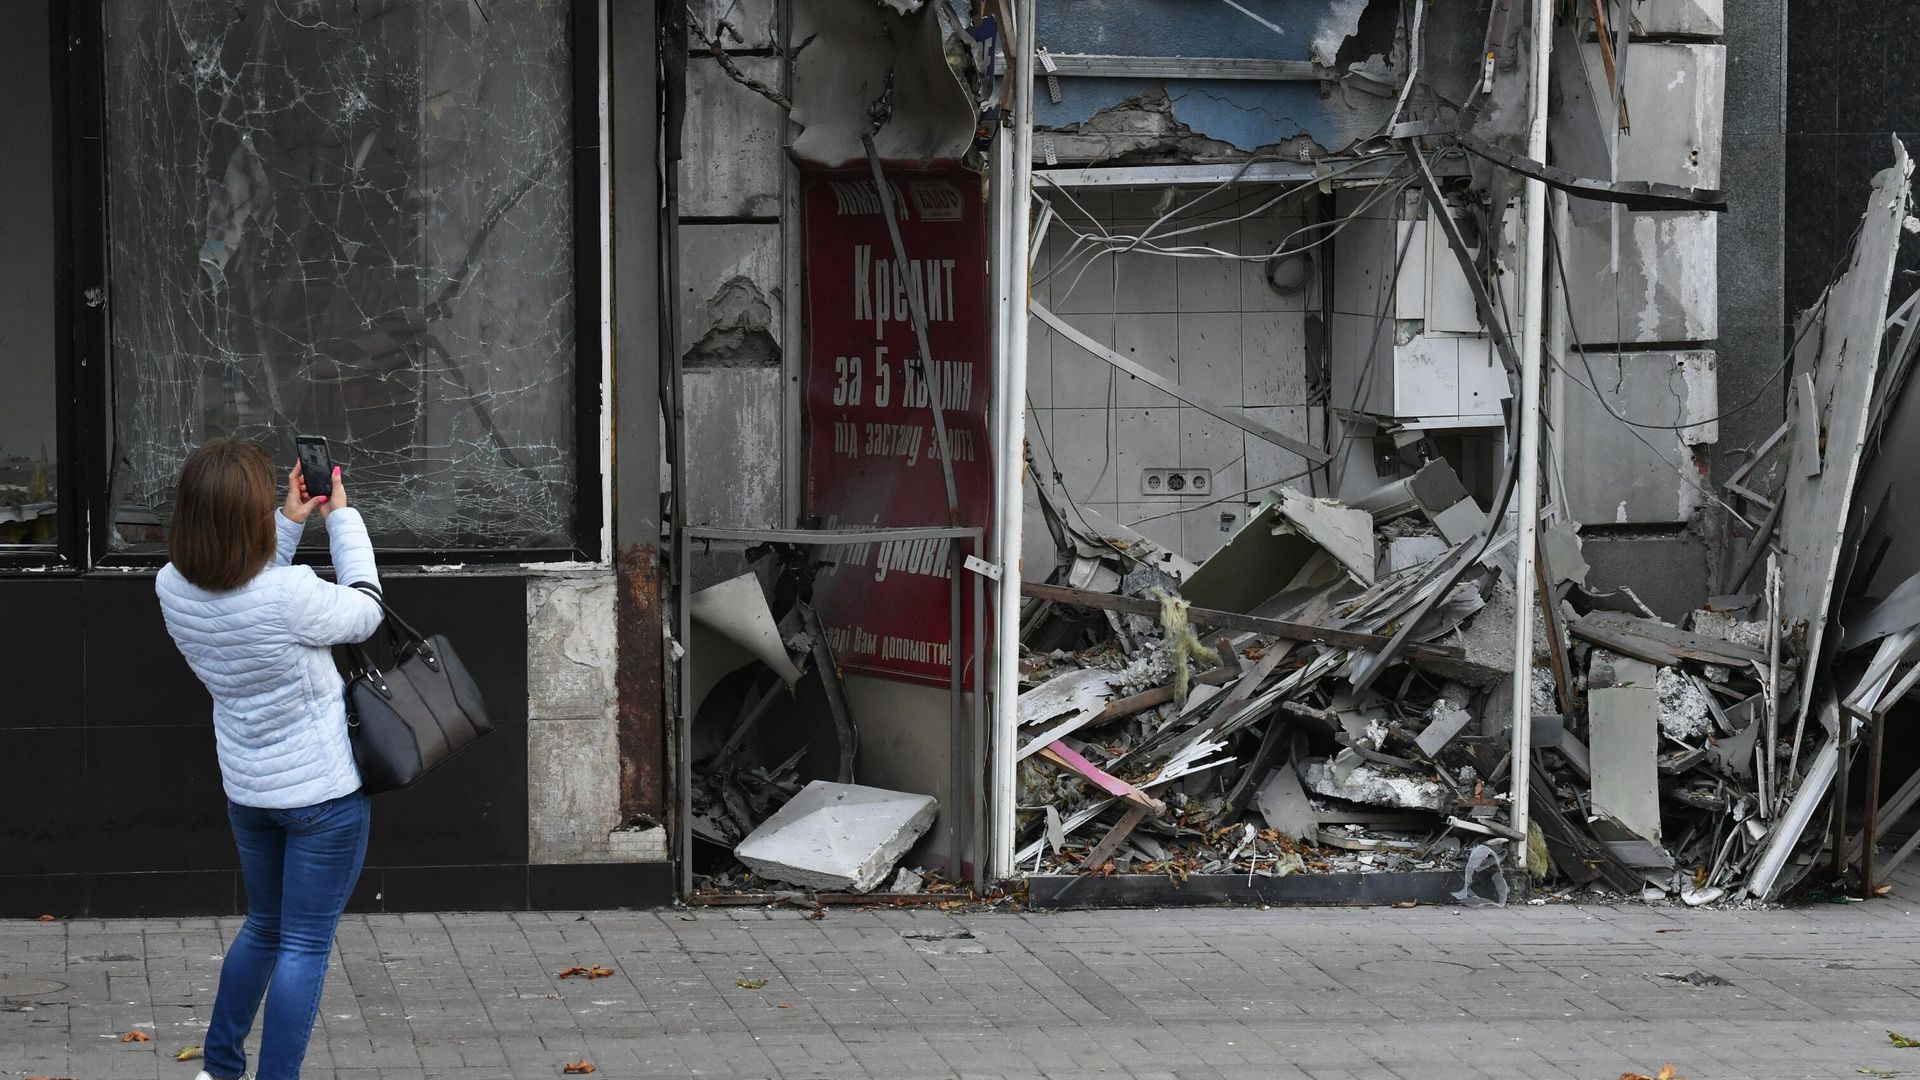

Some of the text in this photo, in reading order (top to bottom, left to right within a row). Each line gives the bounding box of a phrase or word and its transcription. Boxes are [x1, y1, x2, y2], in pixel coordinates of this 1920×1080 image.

[855, 245, 955, 340] Кредит
[833, 357, 862, 406] за
[875, 347, 890, 407] 5
[835, 414, 858, 459] під
[866, 423, 923, 467] заставу
[853, 626, 878, 656] Вам
[881, 636, 952, 666] допомогти!
